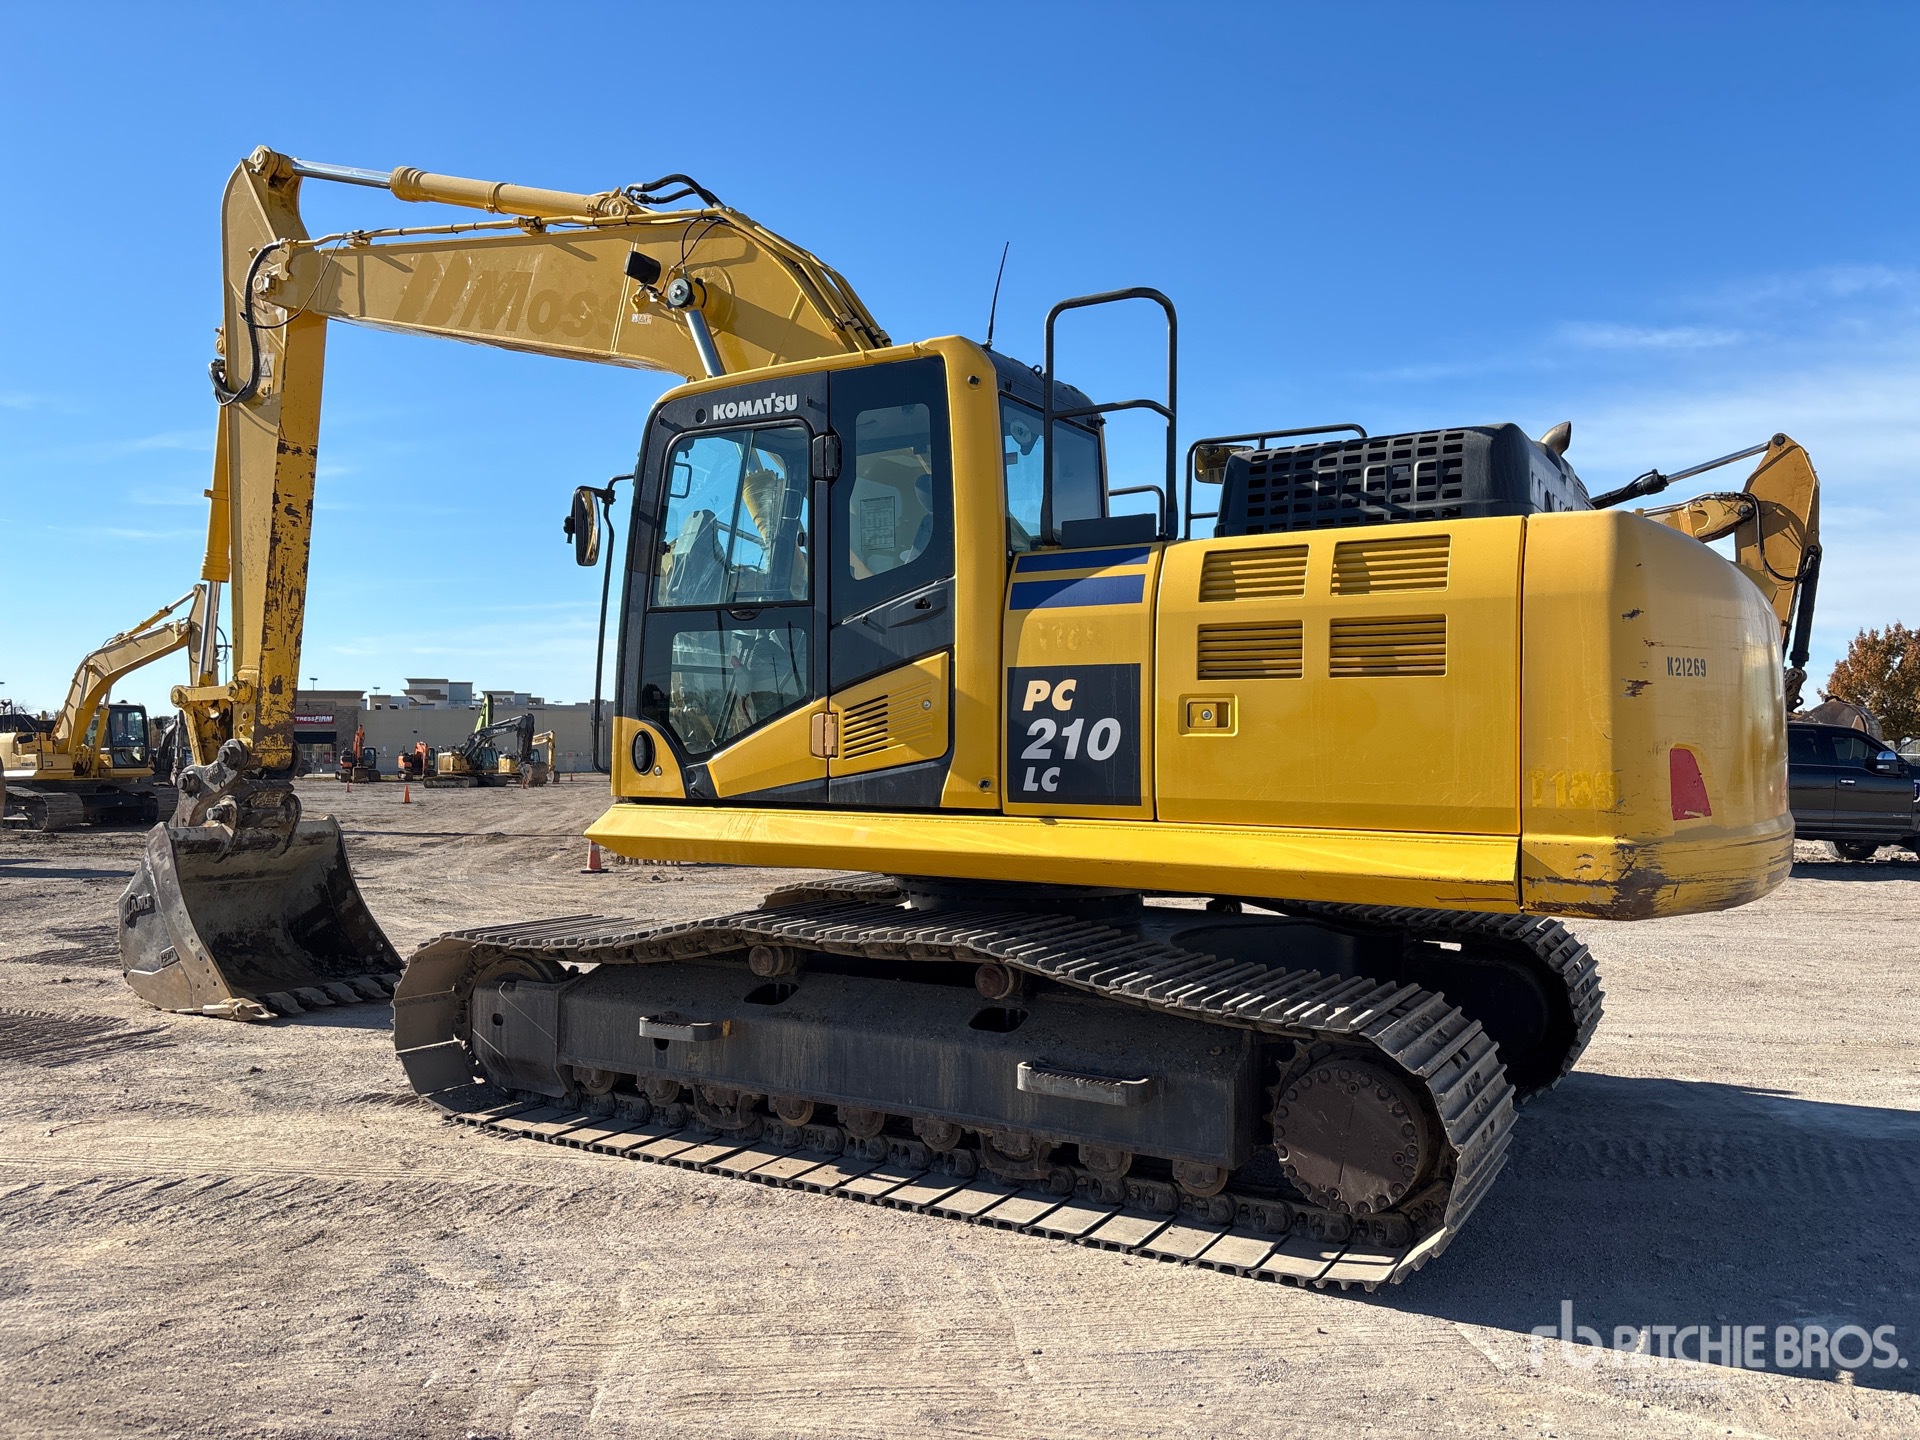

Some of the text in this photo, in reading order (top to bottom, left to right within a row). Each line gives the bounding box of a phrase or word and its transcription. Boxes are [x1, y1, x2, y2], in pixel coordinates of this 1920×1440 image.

[712, 392, 799, 421] KOMATSU
[1666, 656, 1708, 679] K21269
[1022, 679, 1077, 712] PC
[1020, 717, 1122, 761] 210
[1022, 766, 1061, 793] LC
